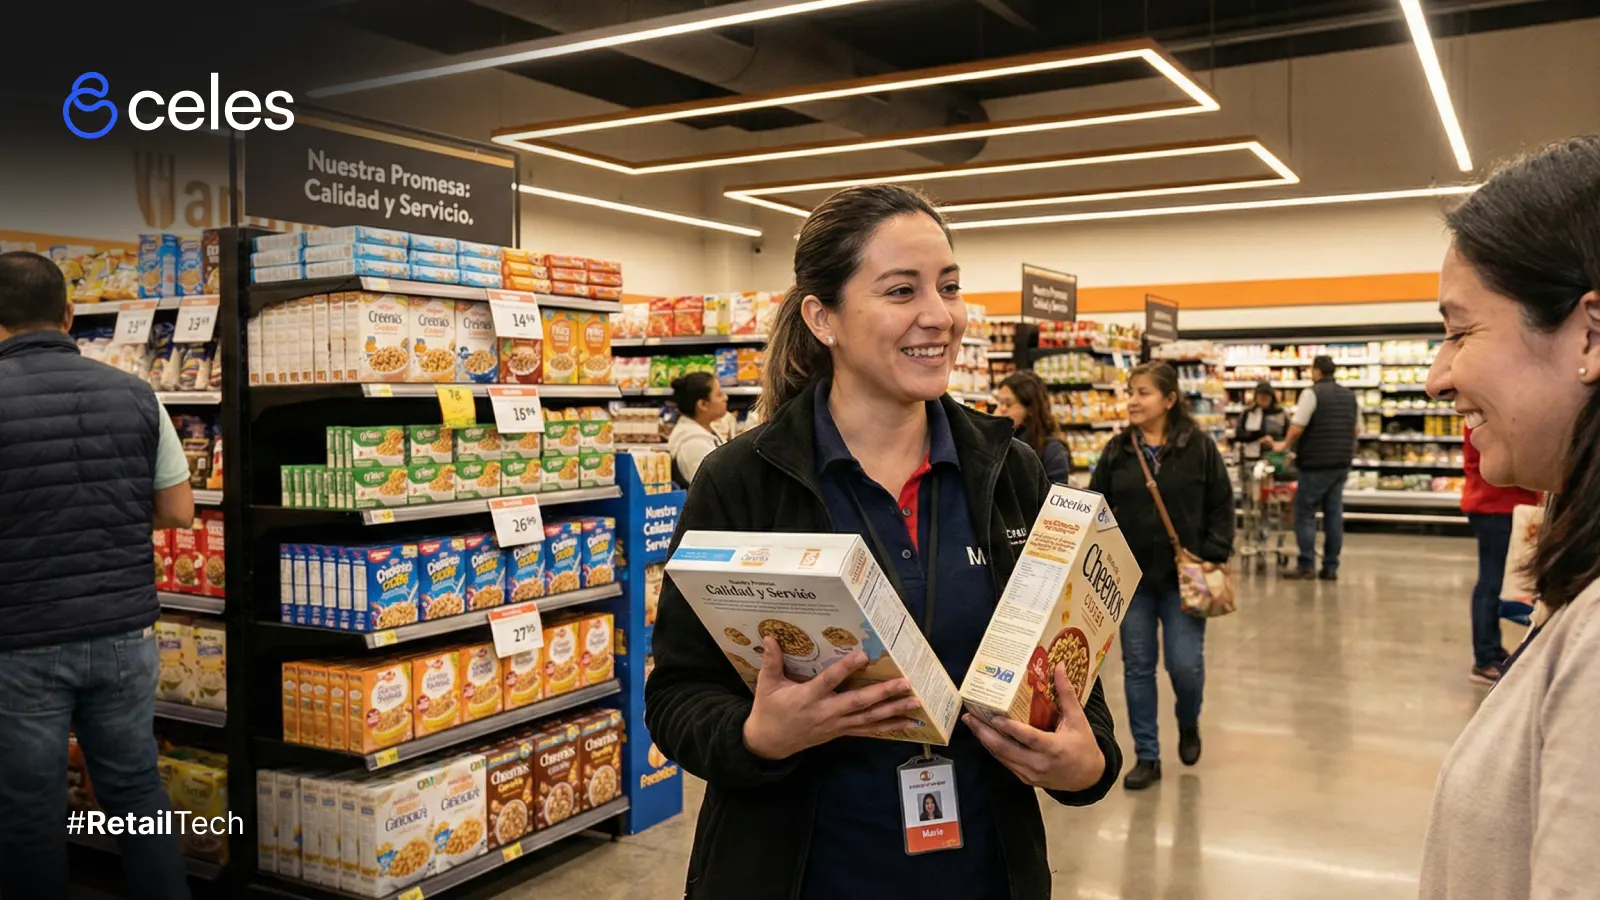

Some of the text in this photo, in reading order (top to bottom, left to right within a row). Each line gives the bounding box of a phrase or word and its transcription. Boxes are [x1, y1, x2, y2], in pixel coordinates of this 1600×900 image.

[307, 148, 471, 198] Nuestra Promesa:
[304, 178, 475, 226] Calidad y Servicio.
[705, 584, 755, 597] Calidad
[756, 589, 765, 599] y
